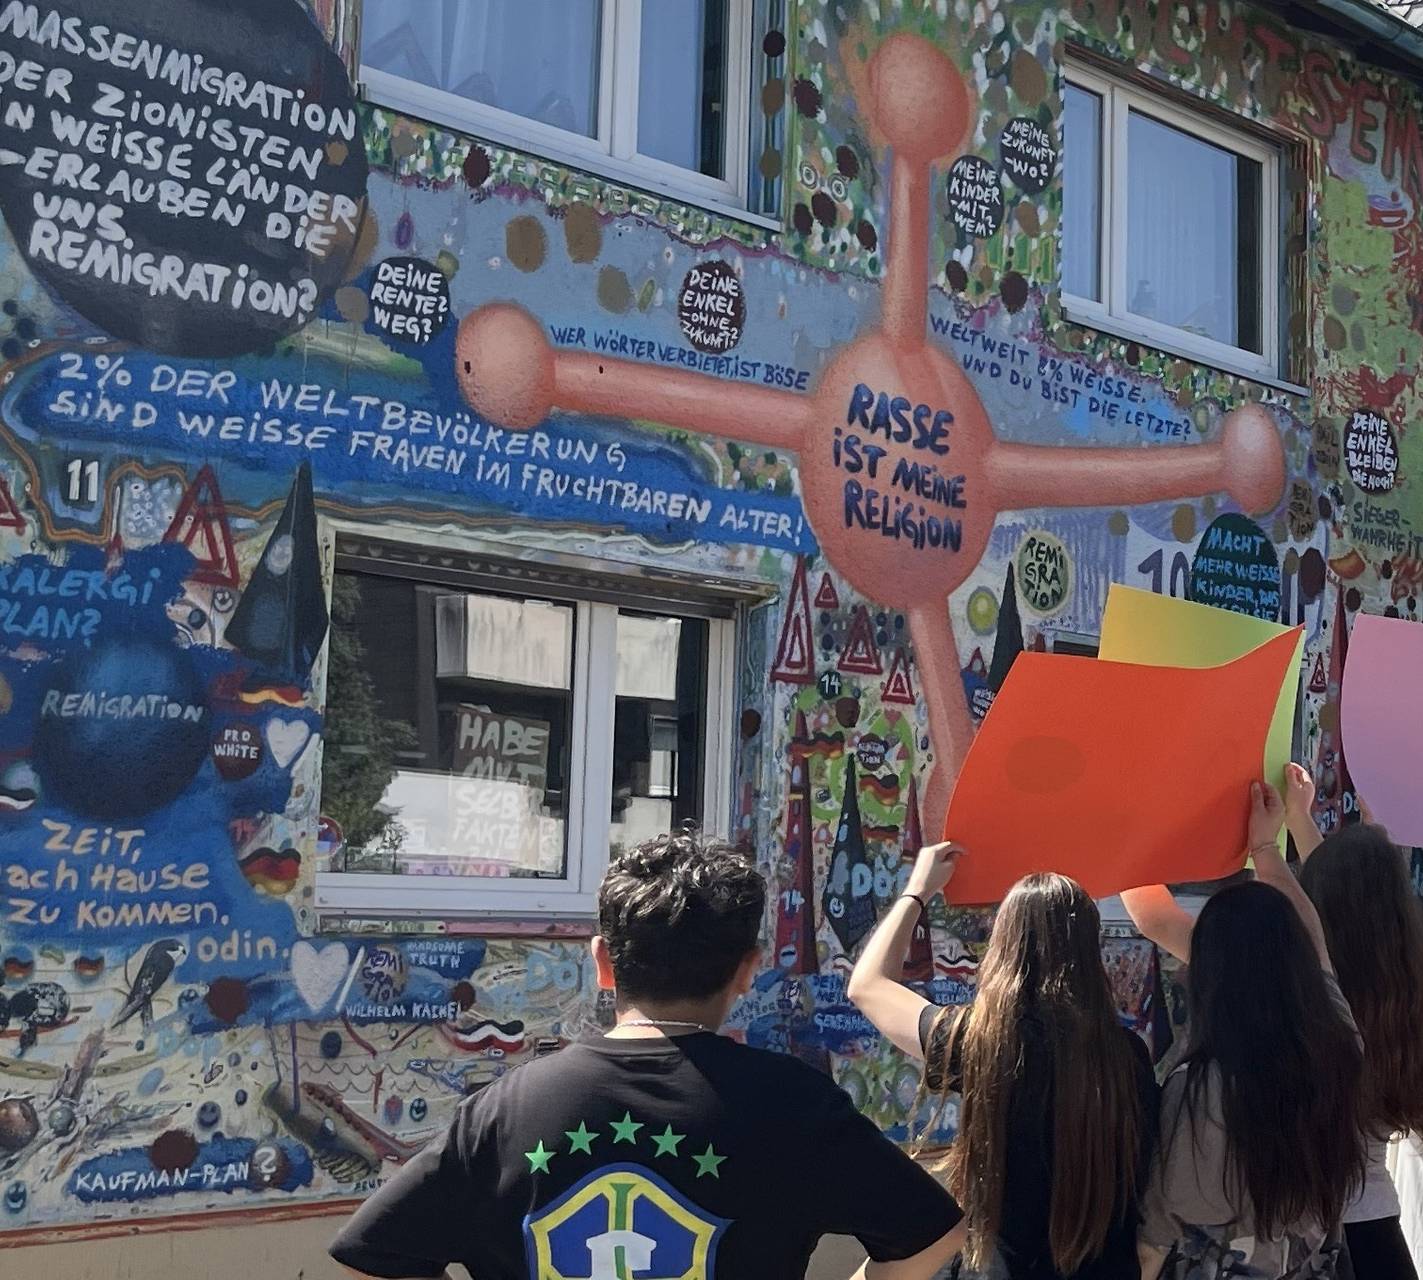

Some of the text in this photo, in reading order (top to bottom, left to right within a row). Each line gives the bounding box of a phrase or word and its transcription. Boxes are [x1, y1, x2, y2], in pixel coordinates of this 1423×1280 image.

[206, 157, 357, 233] LÄNDER
[371, 282, 448, 323] RENTE?
[682, 290, 735, 316] ENKEL
[374, 306, 432, 343] WEG?
[550, 325, 586, 347] WER
[683, 320, 739, 349] ZUKUNFT?
[150, 364, 237, 404] DER
[963, 354, 1001, 378] UND
[1009, 368, 1032, 390] DU
[1125, 410, 1192, 441] LETZTE?
[847, 383, 954, 456] RASSE
[1347, 433, 1395, 455] ENKEL
[67, 459, 100, 502] 11
[521, 463, 712, 524] FRUCHTBAREN
[719, 503, 803, 547] ALTER!
[1206, 527, 1265, 556] MACHT
[1195, 556, 1233, 577] MEHR
[821, 673, 841, 695] 14
[460, 713, 549, 756] HABE
